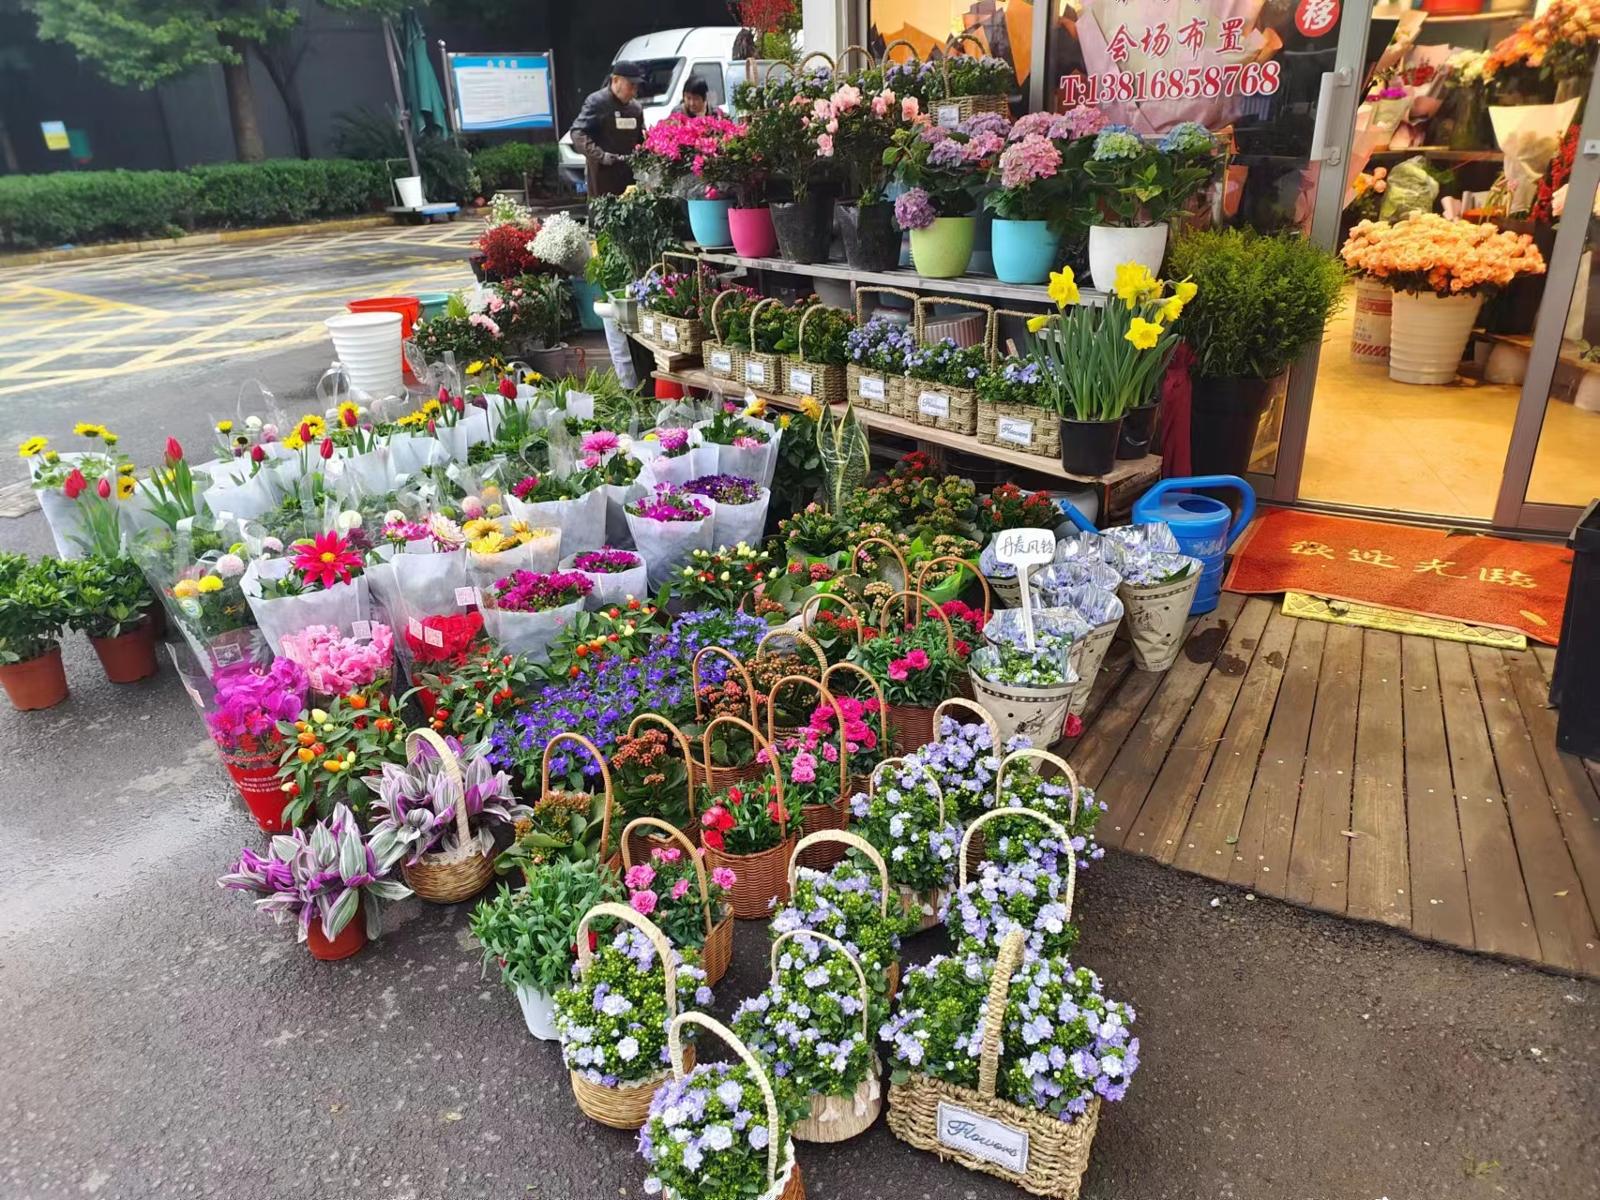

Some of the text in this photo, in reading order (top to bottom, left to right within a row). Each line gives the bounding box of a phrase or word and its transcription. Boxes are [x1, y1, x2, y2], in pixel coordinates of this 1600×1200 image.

[1105, 16, 1245, 61] 会场布置
[1060, 61, 1281, 106] T:13816858768
[947, 1119, 1018, 1158] Flowers
